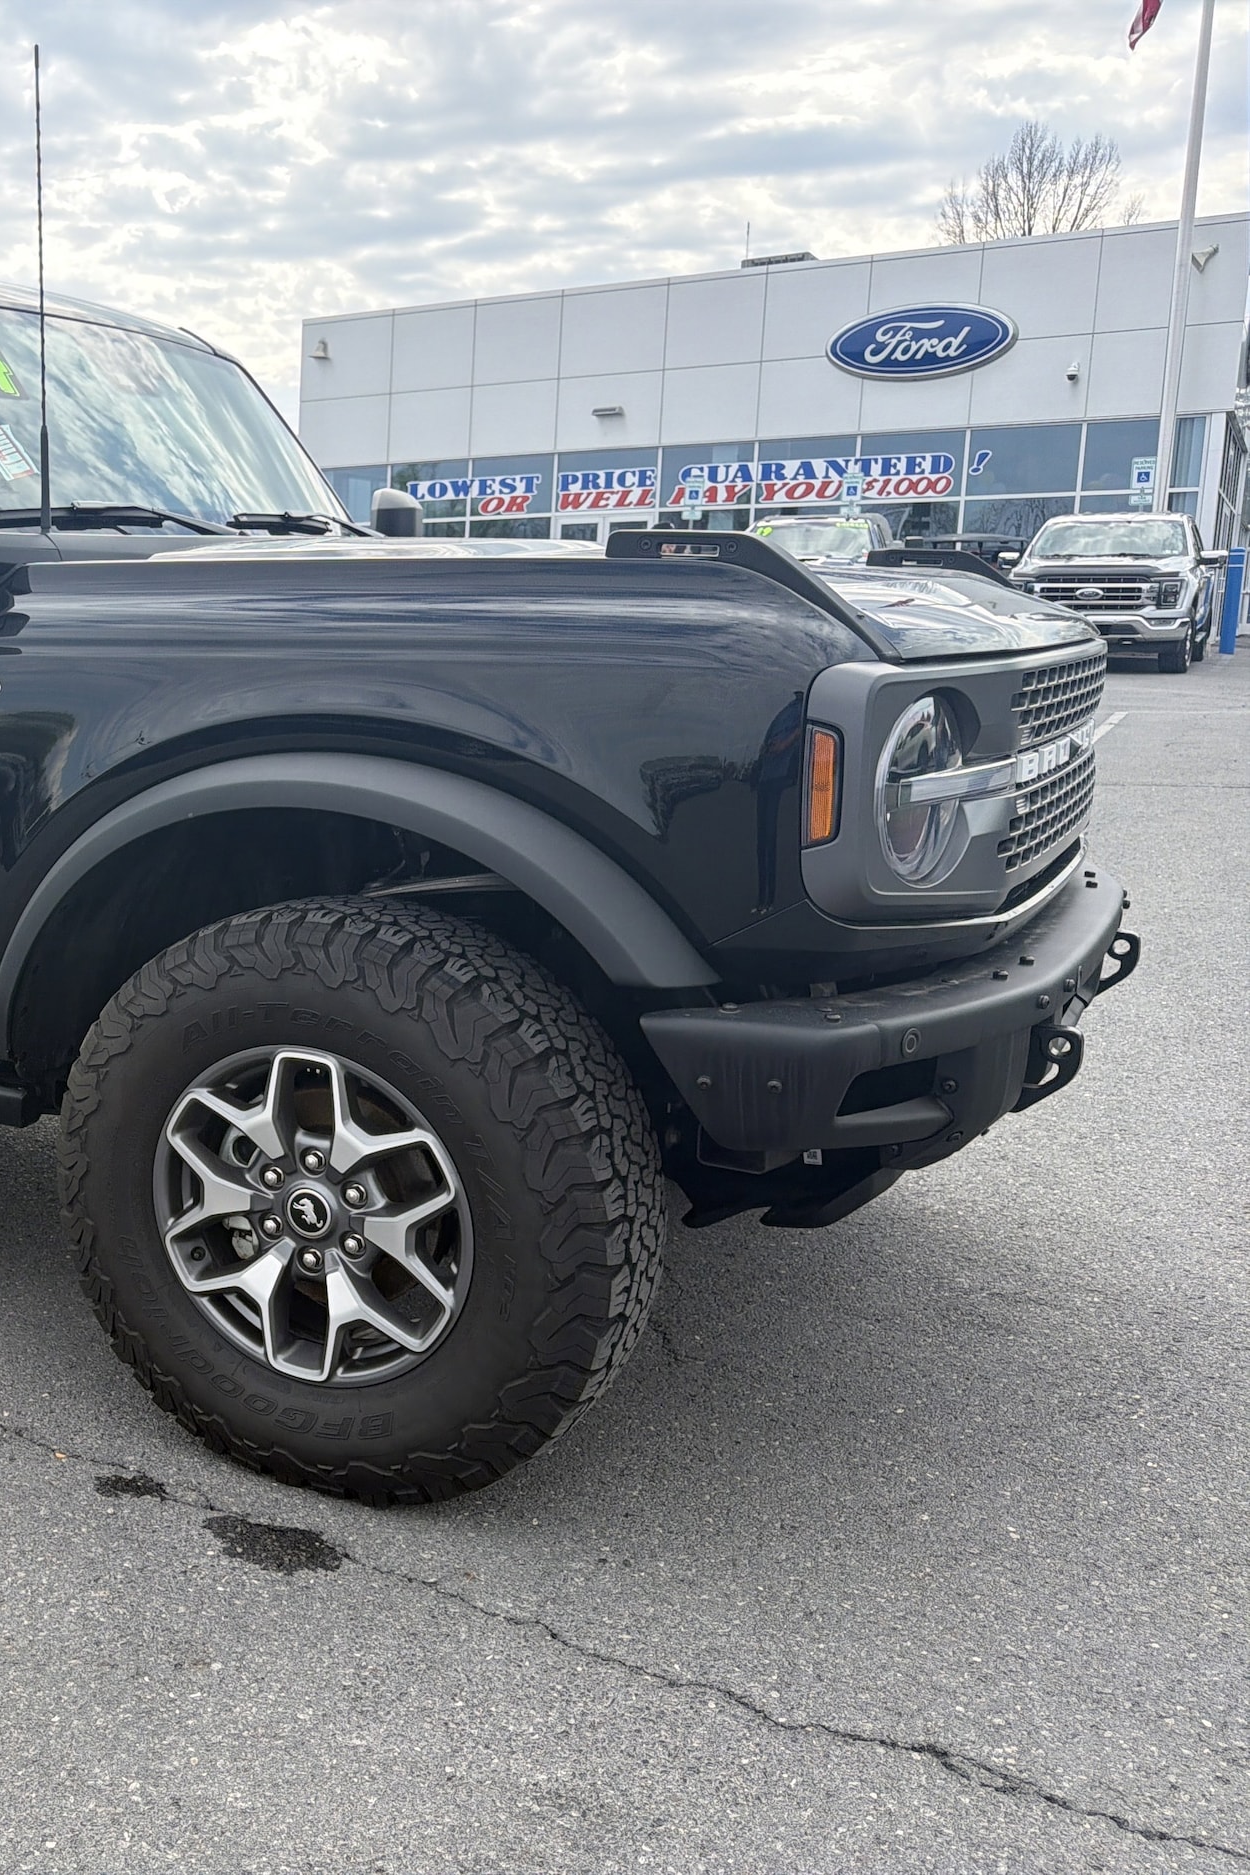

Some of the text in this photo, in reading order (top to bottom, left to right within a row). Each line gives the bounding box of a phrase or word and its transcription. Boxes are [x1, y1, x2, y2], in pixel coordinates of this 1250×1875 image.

[864, 320, 971, 363] Ford
[408, 475, 541, 500] LOWEST
[559, 469, 656, 492] PRICE
[680, 453, 954, 484] GUARANTEED
[969, 452, 991, 474] !
[480, 495, 531, 513] OR
[761, 480, 844, 501] YOU
[862, 476, 952, 498] $1,000
